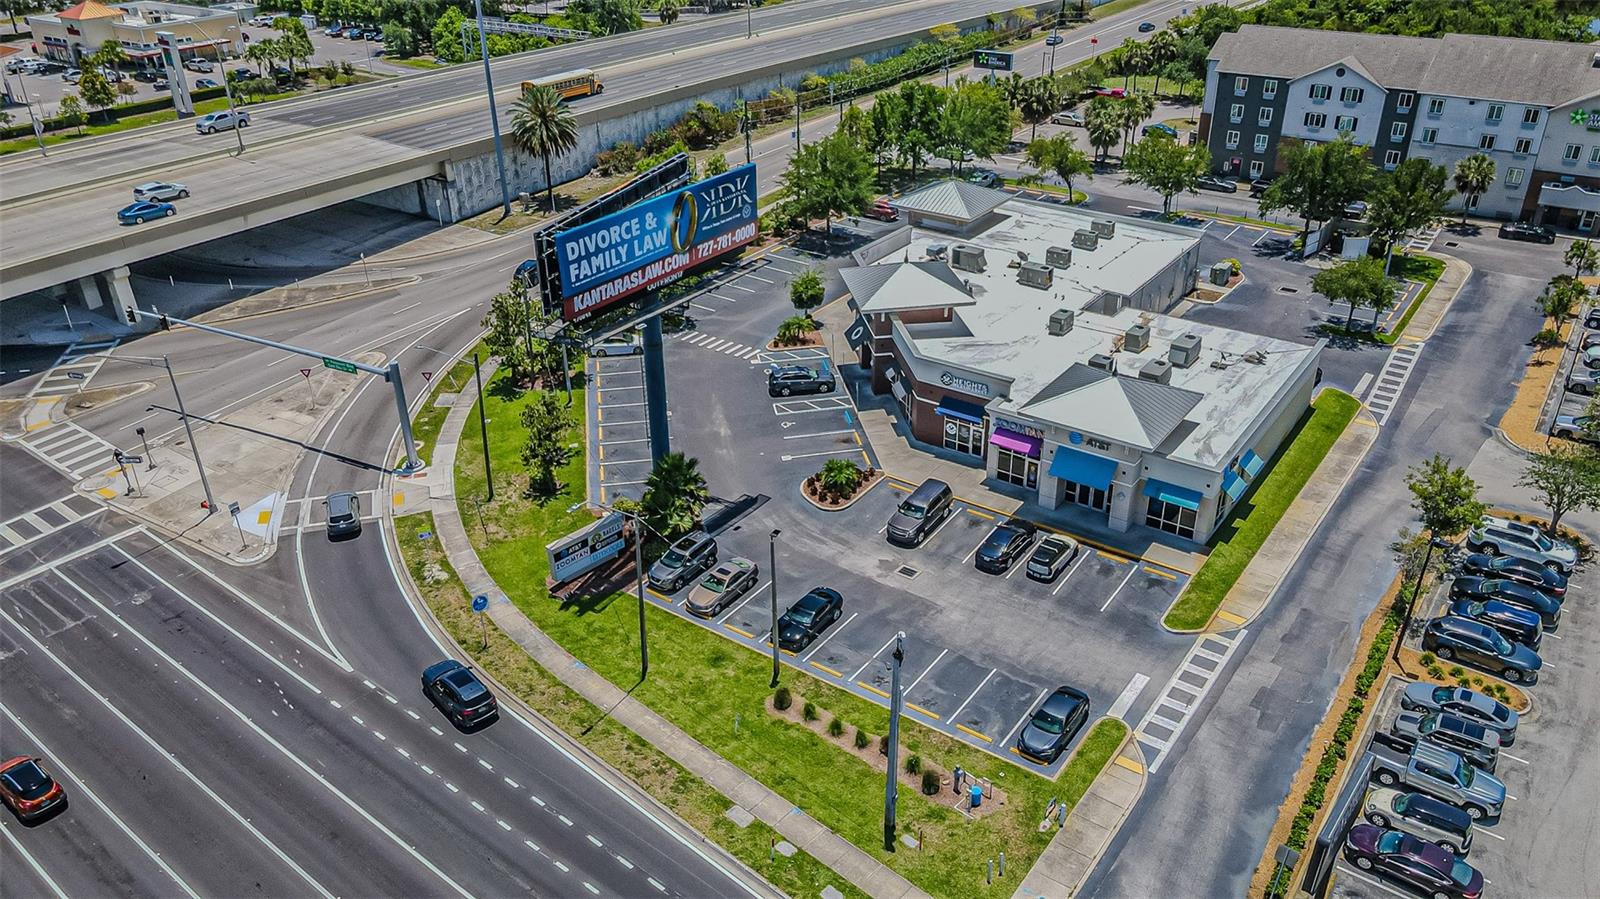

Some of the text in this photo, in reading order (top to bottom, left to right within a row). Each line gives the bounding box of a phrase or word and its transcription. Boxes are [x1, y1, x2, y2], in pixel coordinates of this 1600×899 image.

[566, 211, 657, 261] DIVORCE &
[697, 222, 755, 258] 727-781-0000
[569, 243, 628, 282] FAMILY
[633, 227, 667, 257] LAW
[573, 251, 689, 312] KANTARASLAW.COM
[953, 376, 988, 391] HEIGHTS
[1086, 438, 1112, 451] AT&T
[556, 550, 589, 570] ZOOMTAN
[568, 542, 582, 554] AT&T
